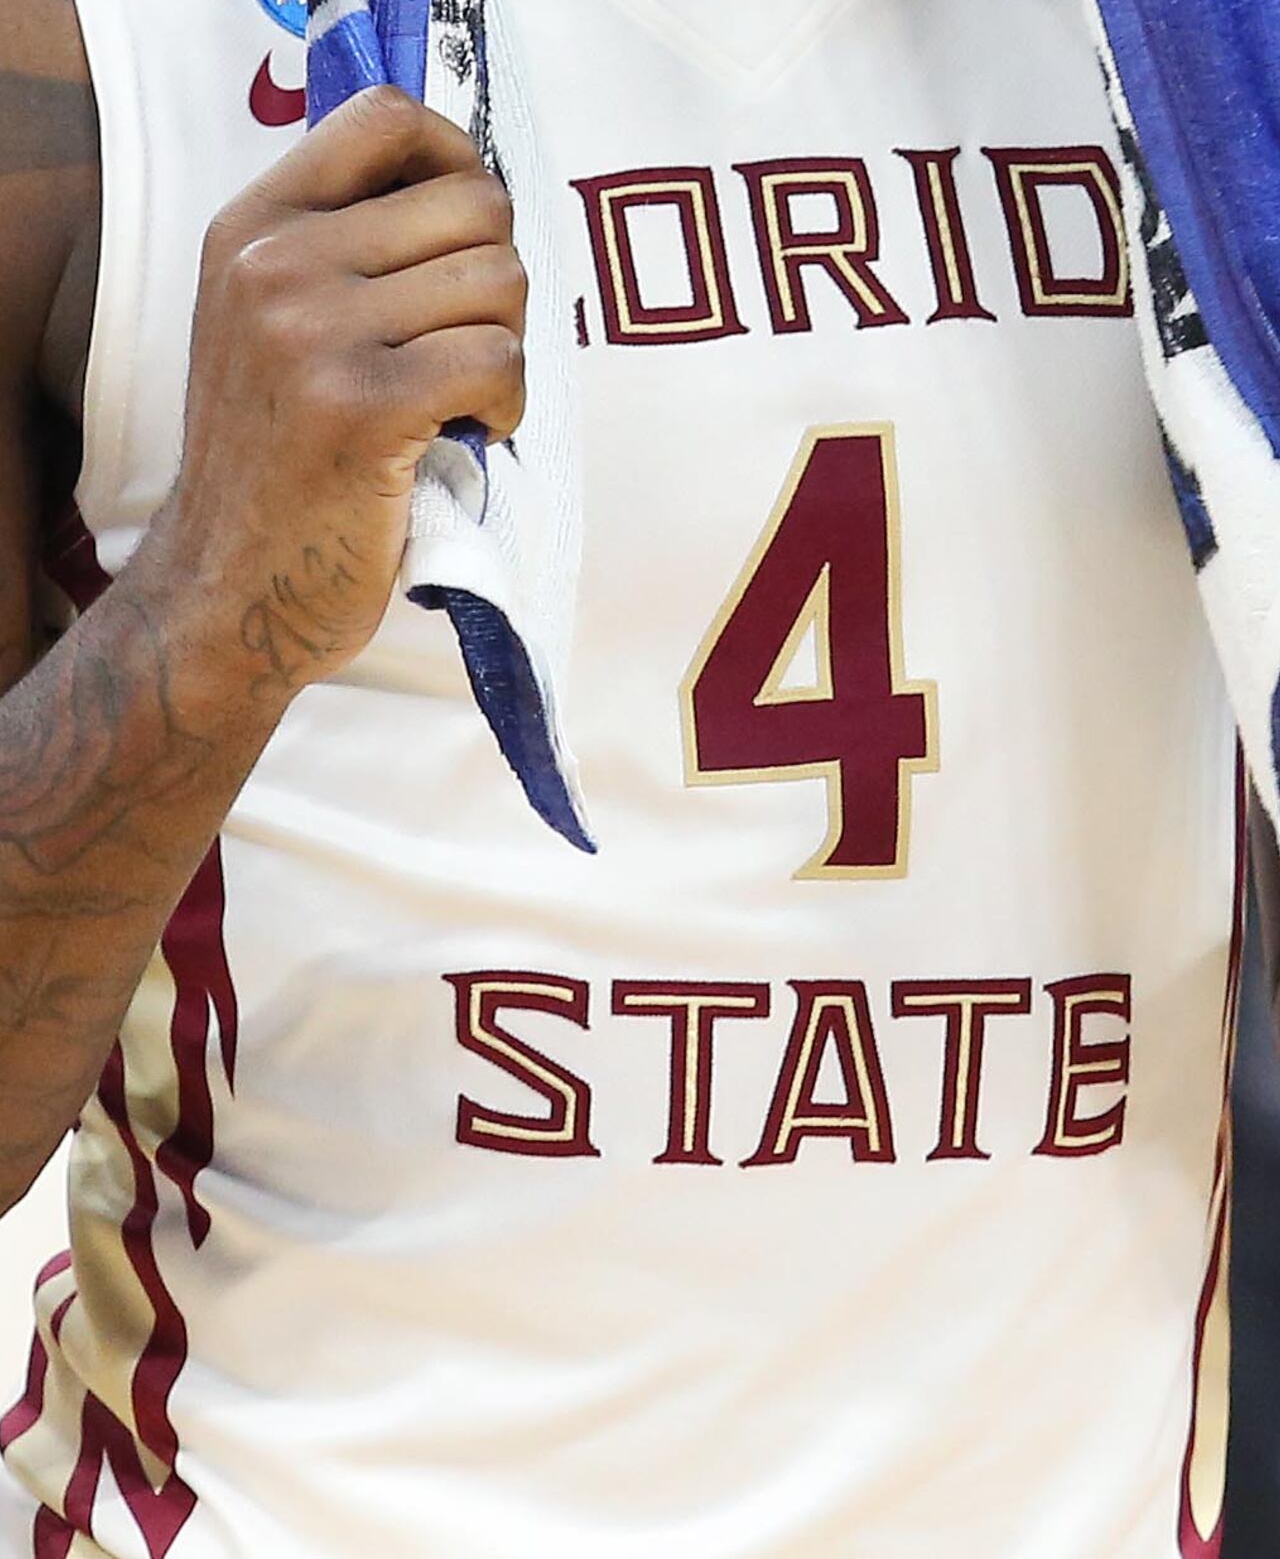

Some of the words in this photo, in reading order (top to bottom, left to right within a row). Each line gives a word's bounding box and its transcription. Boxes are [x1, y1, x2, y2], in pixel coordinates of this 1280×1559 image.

[570, 146, 1133, 348] ORID
[678, 421, 940, 880] 4
[442, 970, 1132, 1167] STATE
